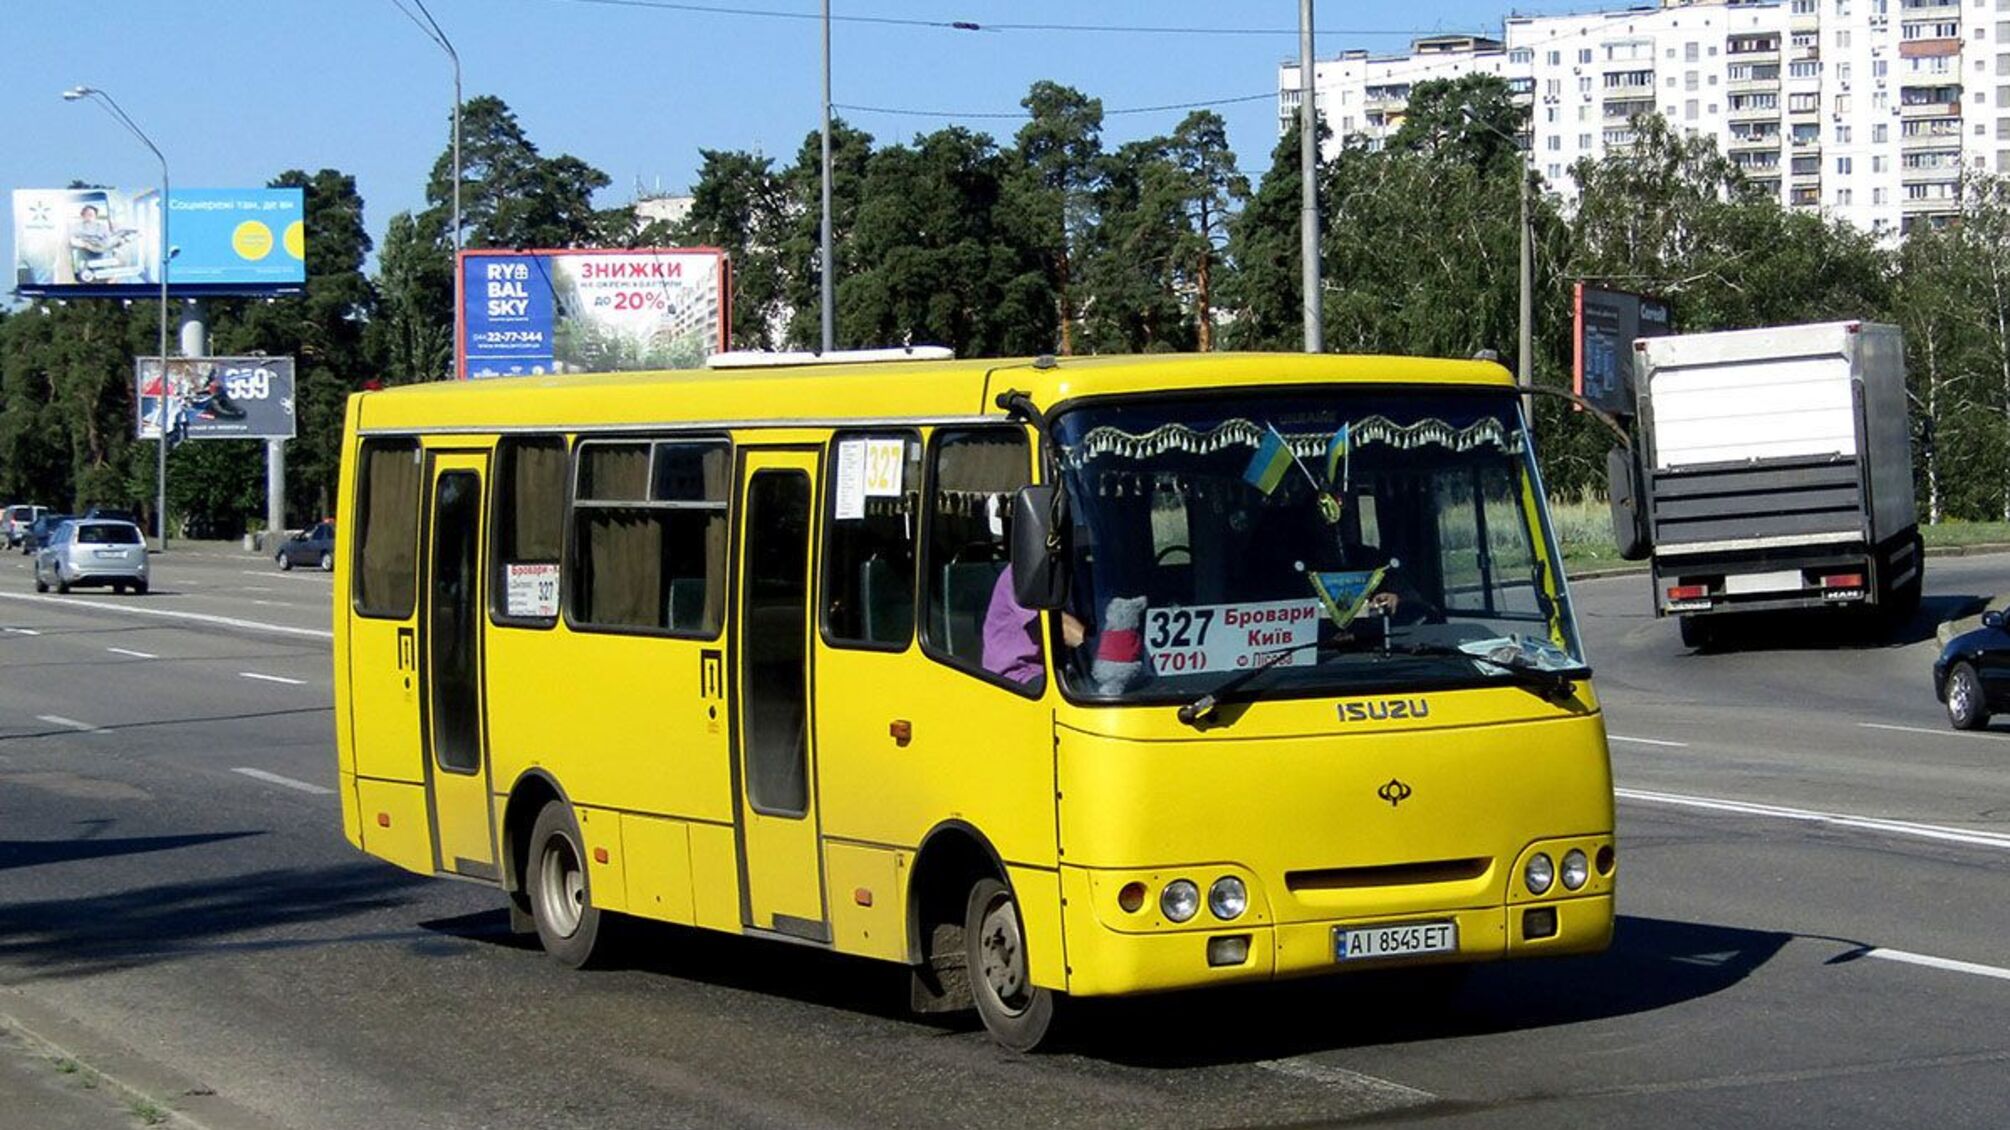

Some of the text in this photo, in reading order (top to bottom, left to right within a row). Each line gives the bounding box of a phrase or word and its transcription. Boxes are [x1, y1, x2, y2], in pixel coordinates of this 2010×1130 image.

[581, 262, 682, 278] ЗНИЖКИ
[488, 281, 528, 298] BAL
[488, 299, 529, 316] SKY
[614, 291, 666, 310] 20%
[868, 445, 900, 489] 327
[538, 581, 553, 600] 327
[1224, 606, 1315, 628] Бровари
[1150, 609, 1214, 648] 327
[1247, 628, 1293, 647] Київ
[1151, 651, 1208, 672] (701)
[1337, 699, 1429, 722] ISUZU
[1379, 929, 1421, 952] 8545
[1424, 926, 1450, 949] ET
